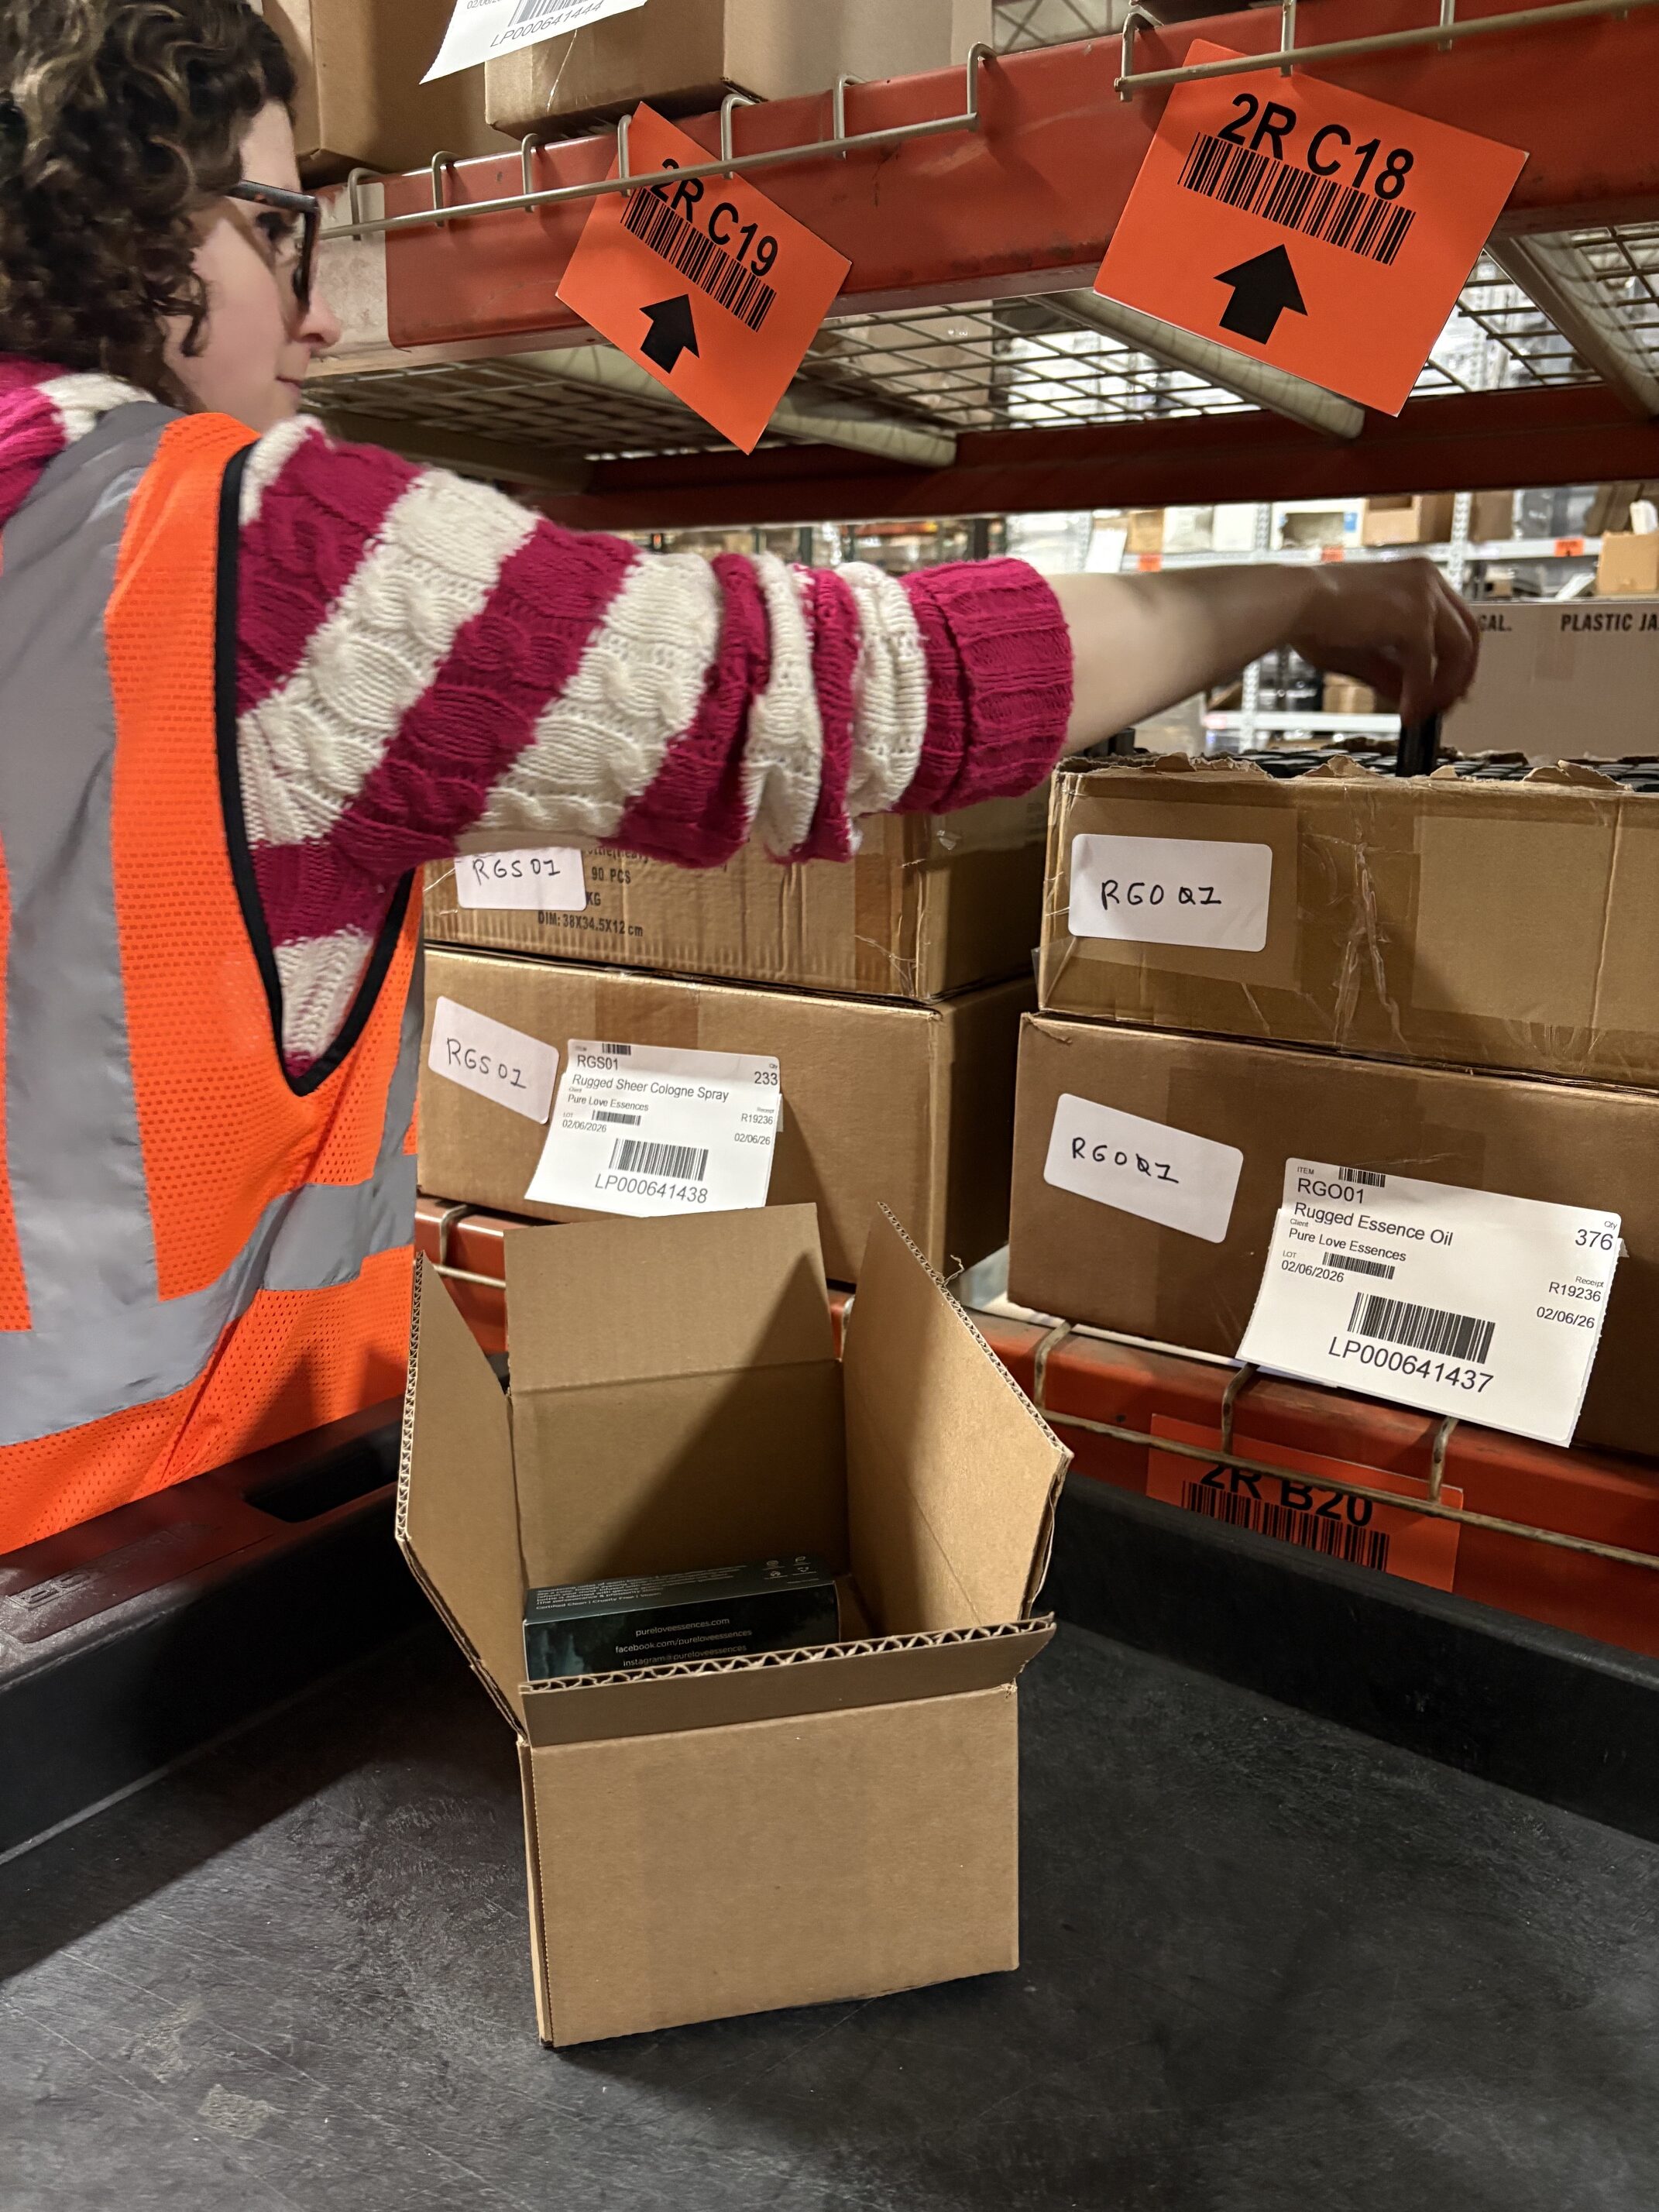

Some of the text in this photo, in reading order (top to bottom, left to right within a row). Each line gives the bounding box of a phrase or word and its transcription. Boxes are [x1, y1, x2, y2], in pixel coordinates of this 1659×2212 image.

[489, 0, 604, 47] LP000641444
[1218, 92, 1414, 201] 2R C18
[650, 158, 778, 276] 2R C19
[1561, 613, 1633, 632] PLASTIC
[591, 866, 631, 884] 90 PCS
[628, 925, 644, 936] cm
[576, 1054, 619, 1070] RGS01
[754, 1070, 778, 1086] 233
[572, 1073, 730, 1104] Rugged Sheer Cologne Spray
[568, 1094, 650, 1113] Pure Love Essences
[562, 1119, 607, 1133] 02/06/2026
[740, 1113, 774, 1125] R19236
[734, 1132, 771, 1146] 02/06/26
[1297, 1166, 1314, 1176] ITEM
[595, 1173, 709, 1204] LP000641438
[1297, 1177, 1365, 1204] RGO01
[1290, 1218, 1309, 1228] Client
[1294, 1202, 1454, 1246] Rugged Essence Oil
[1604, 1221, 1618, 1230] Qty
[1289, 1228, 1407, 1262] Pure Love Essences
[1575, 1228, 1613, 1251] 376
[1283, 1249, 1297, 1259] LOT
[1281, 1260, 1345, 1283] 02/06/2026
[1548, 1281, 1602, 1302] R19236
[1575, 1276, 1604, 1288] Receipt
[1536, 1306, 1595, 1329] 02/06/26
[1328, 1336, 1494, 1393] LP000641437
[1280, 1479, 1373, 1527] B20
